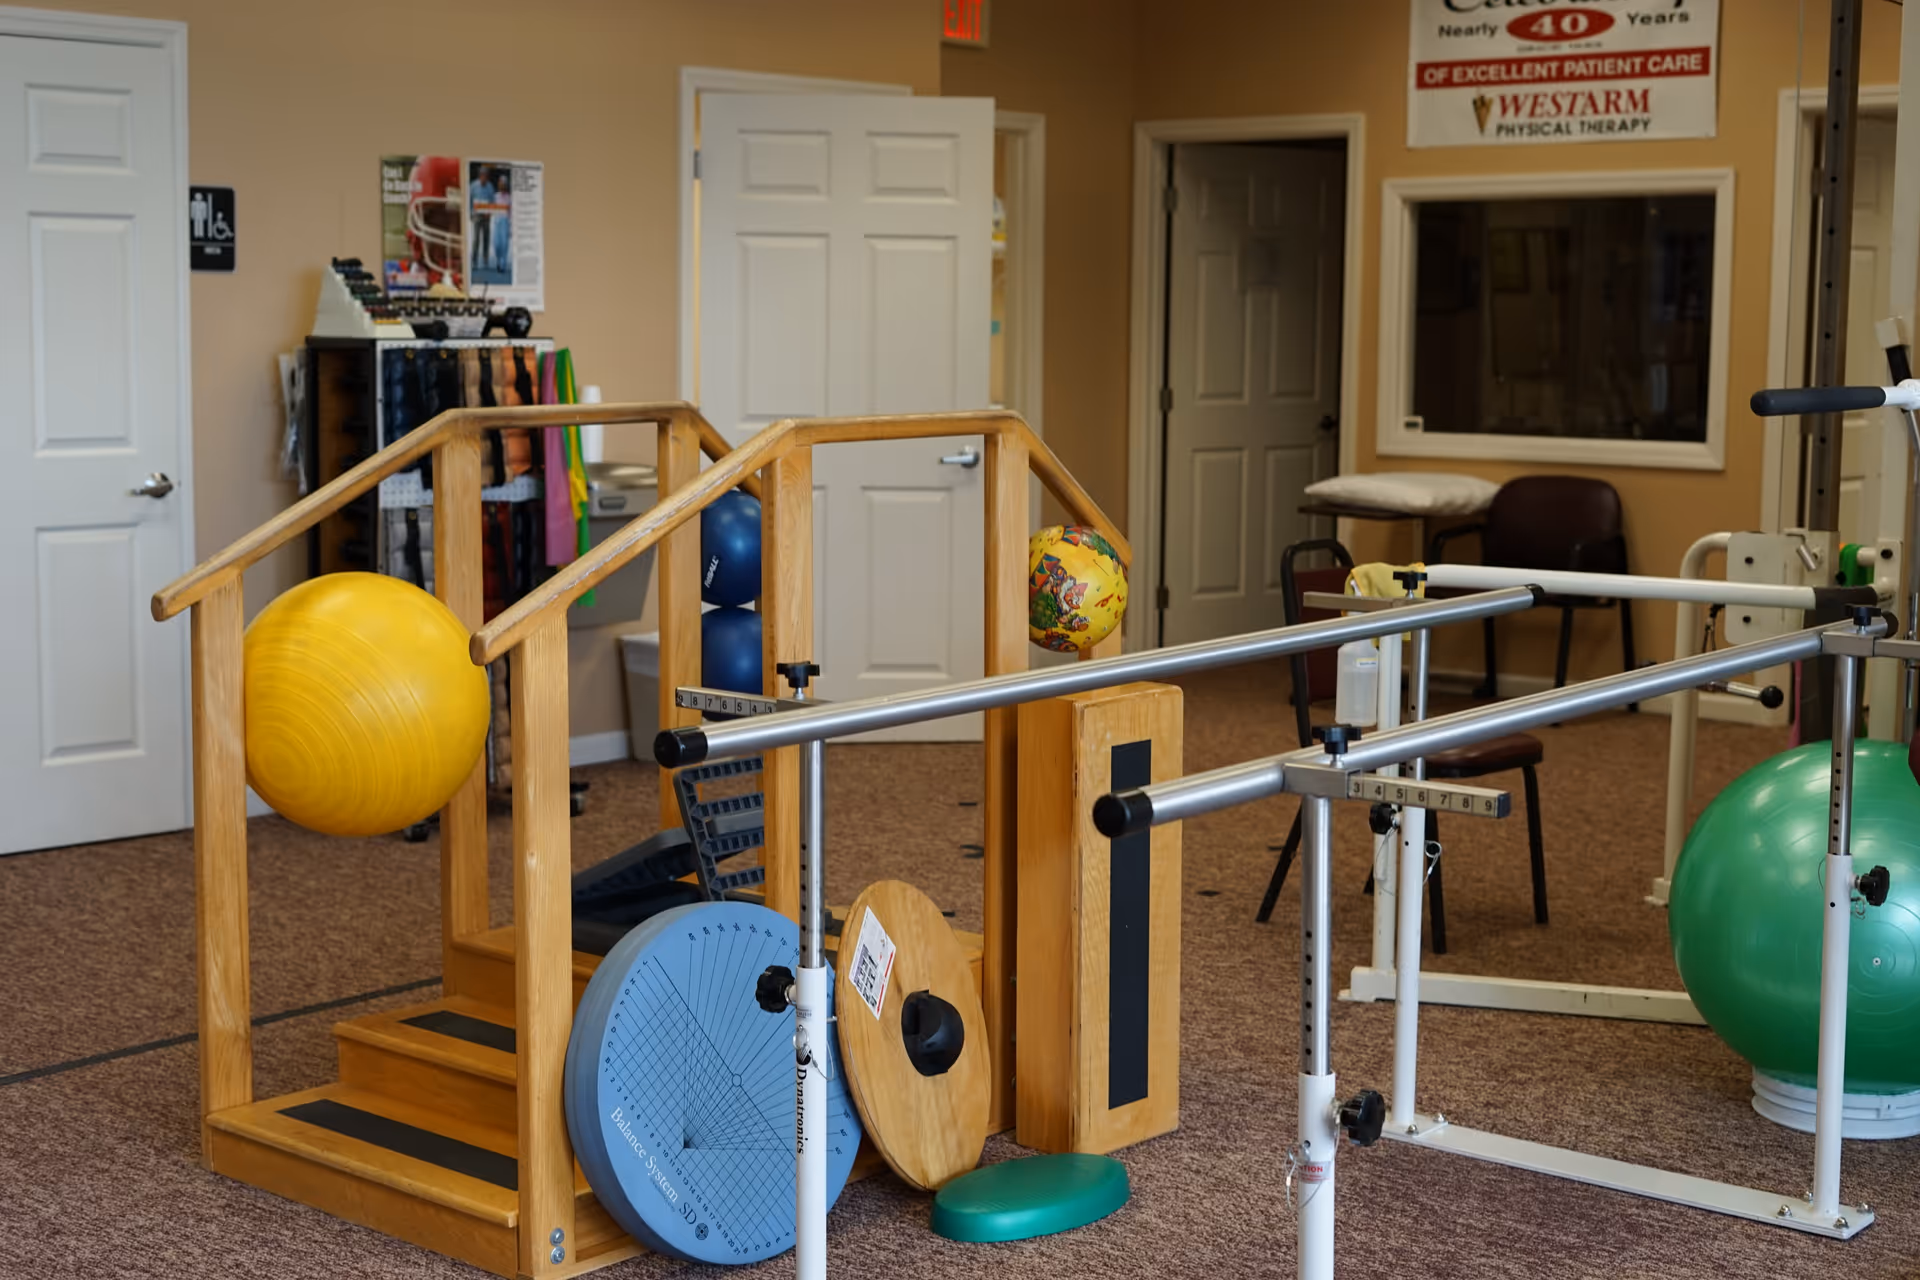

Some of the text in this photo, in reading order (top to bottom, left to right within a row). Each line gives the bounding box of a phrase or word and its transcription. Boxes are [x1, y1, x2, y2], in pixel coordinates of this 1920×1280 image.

[1438, 12, 1690, 38] Nearly 40 Years
[1424, 53, 1704, 84] OF EXCELLENT PATIENT CARE
[1499, 88, 1651, 118] WESTARM
[1495, 118, 1651, 137] PHYSICAL THERAPY
[692, 697, 698, 706] 8
[707, 698, 713, 708] 7
[722, 700, 728, 710] 6
[736, 702, 742, 712] 5
[752, 704, 758, 713] 4
[1353, 782, 1492, 812] 3 4 5 6 7 8 9
[796, 1067, 809, 1155] Dynatronics
[610, 1106, 647, 1158] Balance
[645, 1155, 679, 1203] System
[679, 1202, 697, 1225] SD
